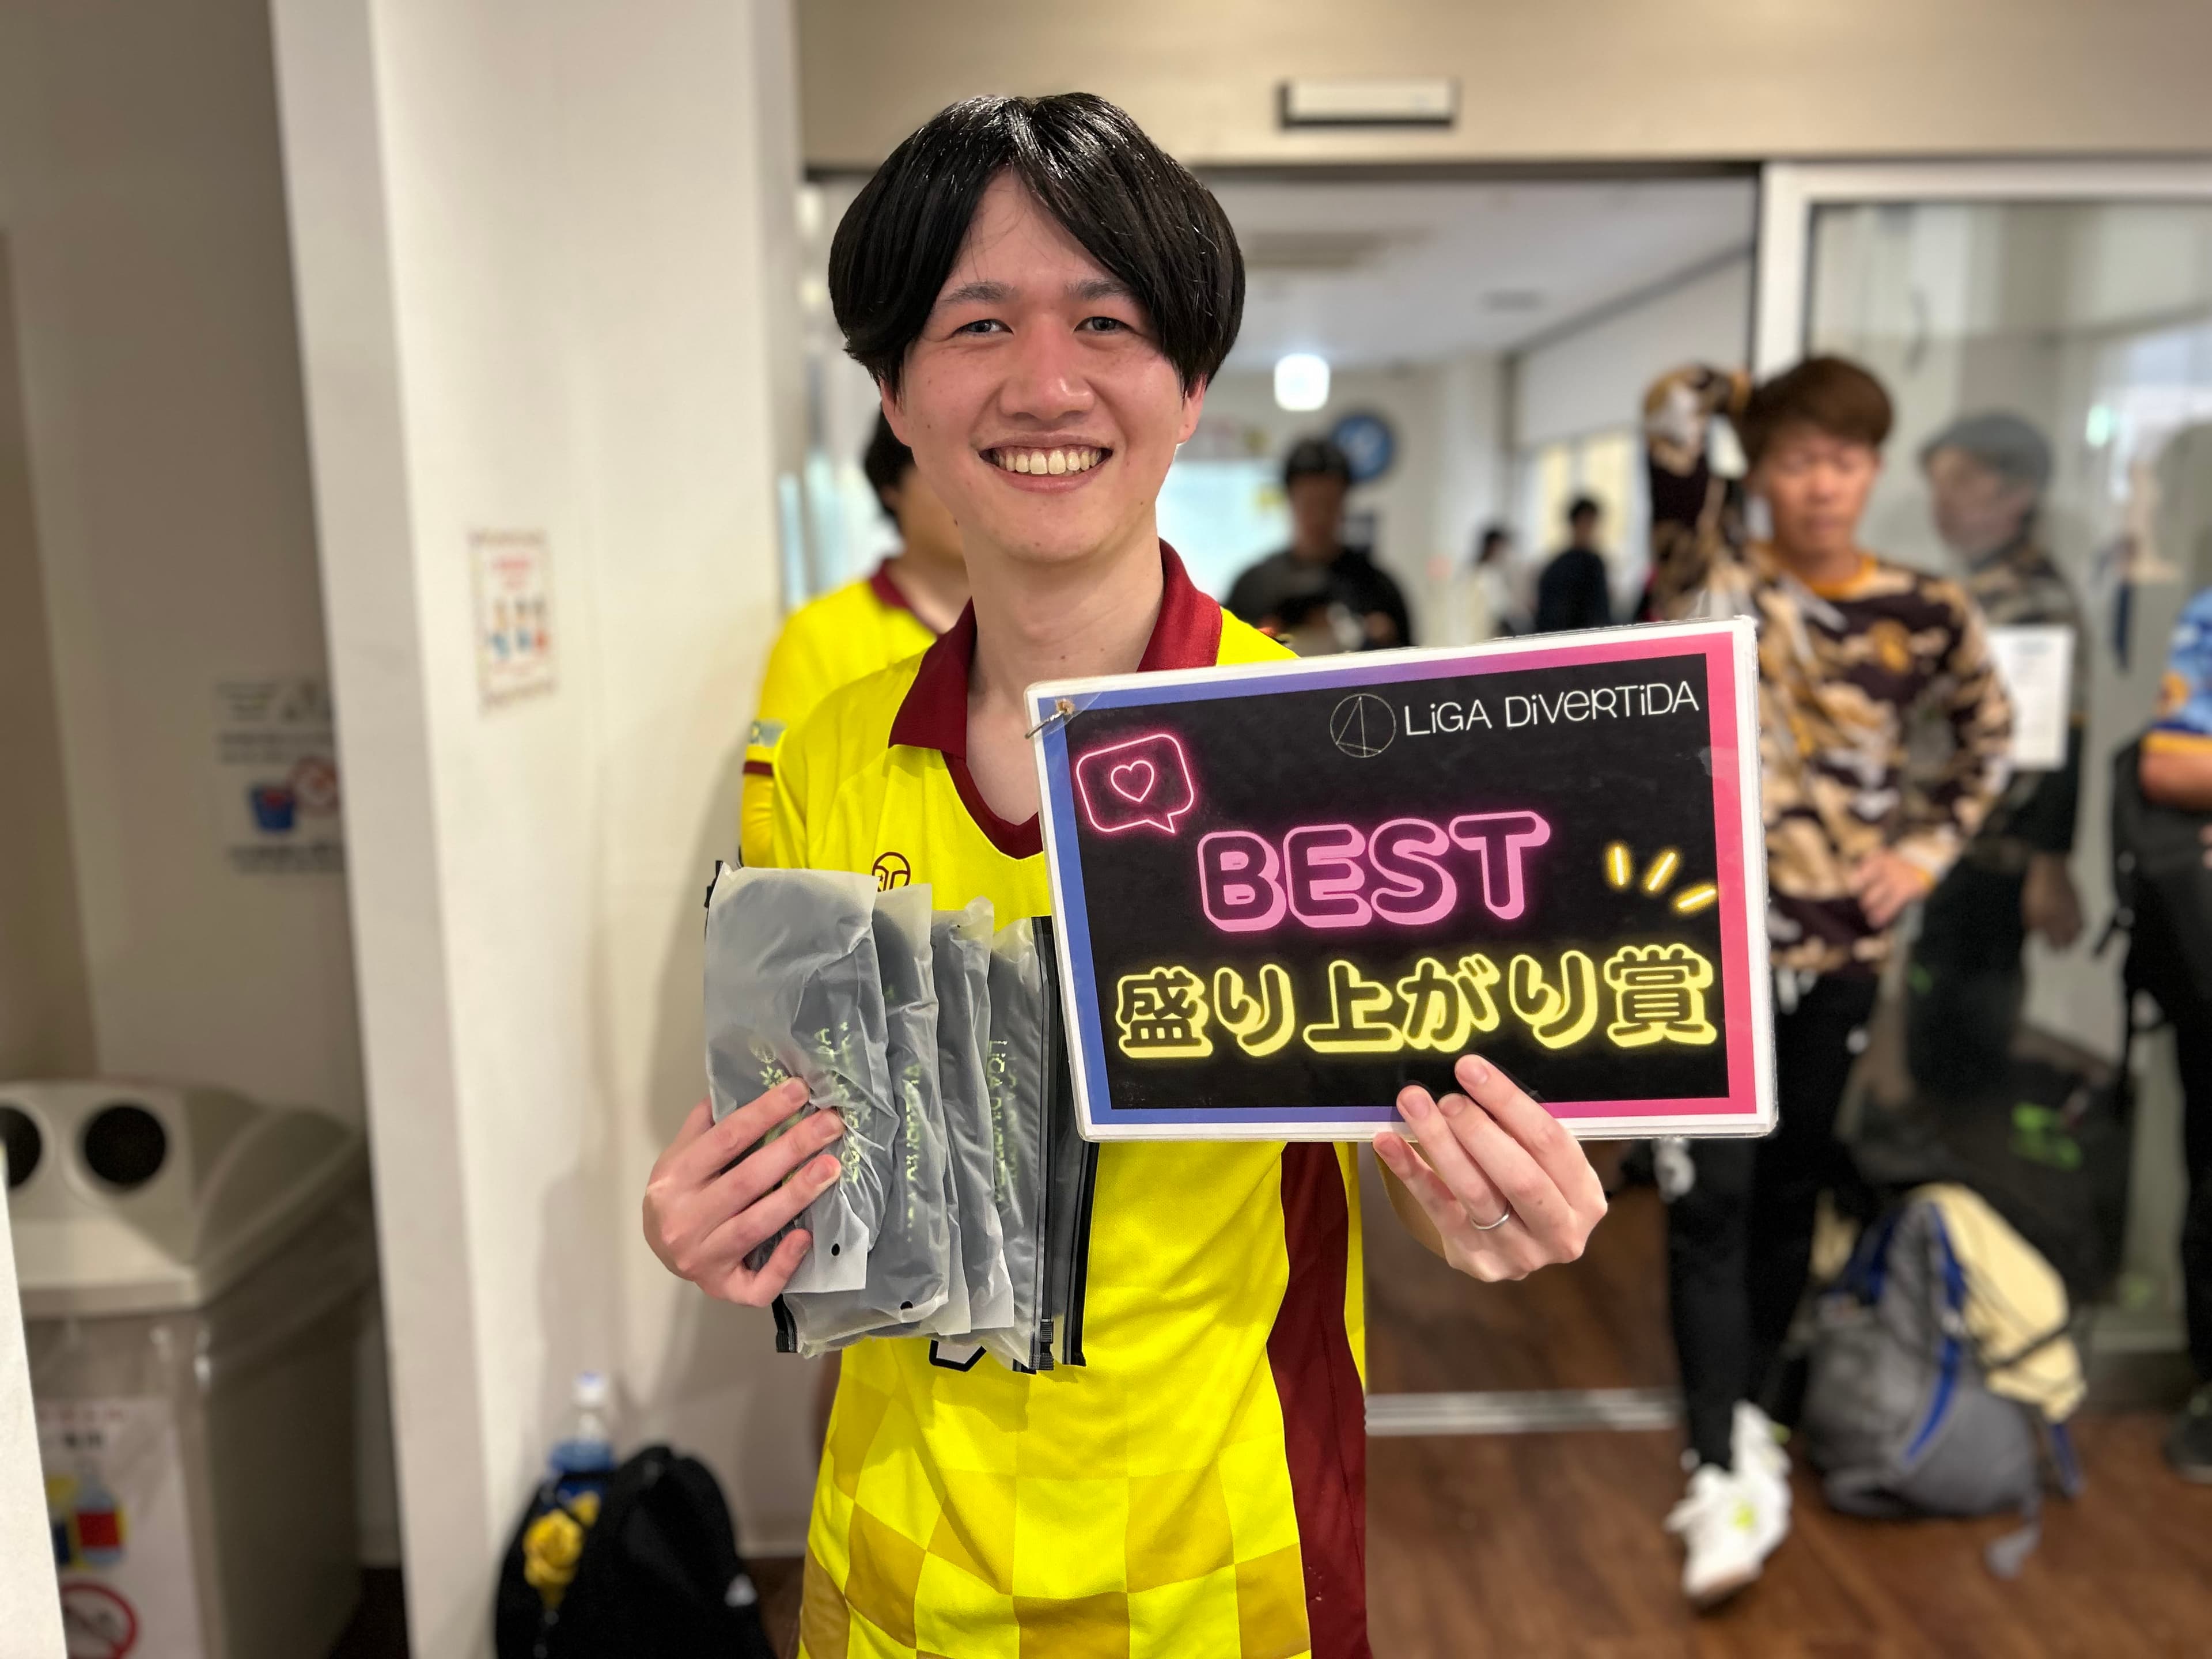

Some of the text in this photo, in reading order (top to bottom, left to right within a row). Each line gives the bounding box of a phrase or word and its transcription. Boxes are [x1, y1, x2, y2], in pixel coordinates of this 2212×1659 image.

[1196, 810, 1551, 933] BEST
[1115, 942, 1718, 1059] 盛り上がり賞
